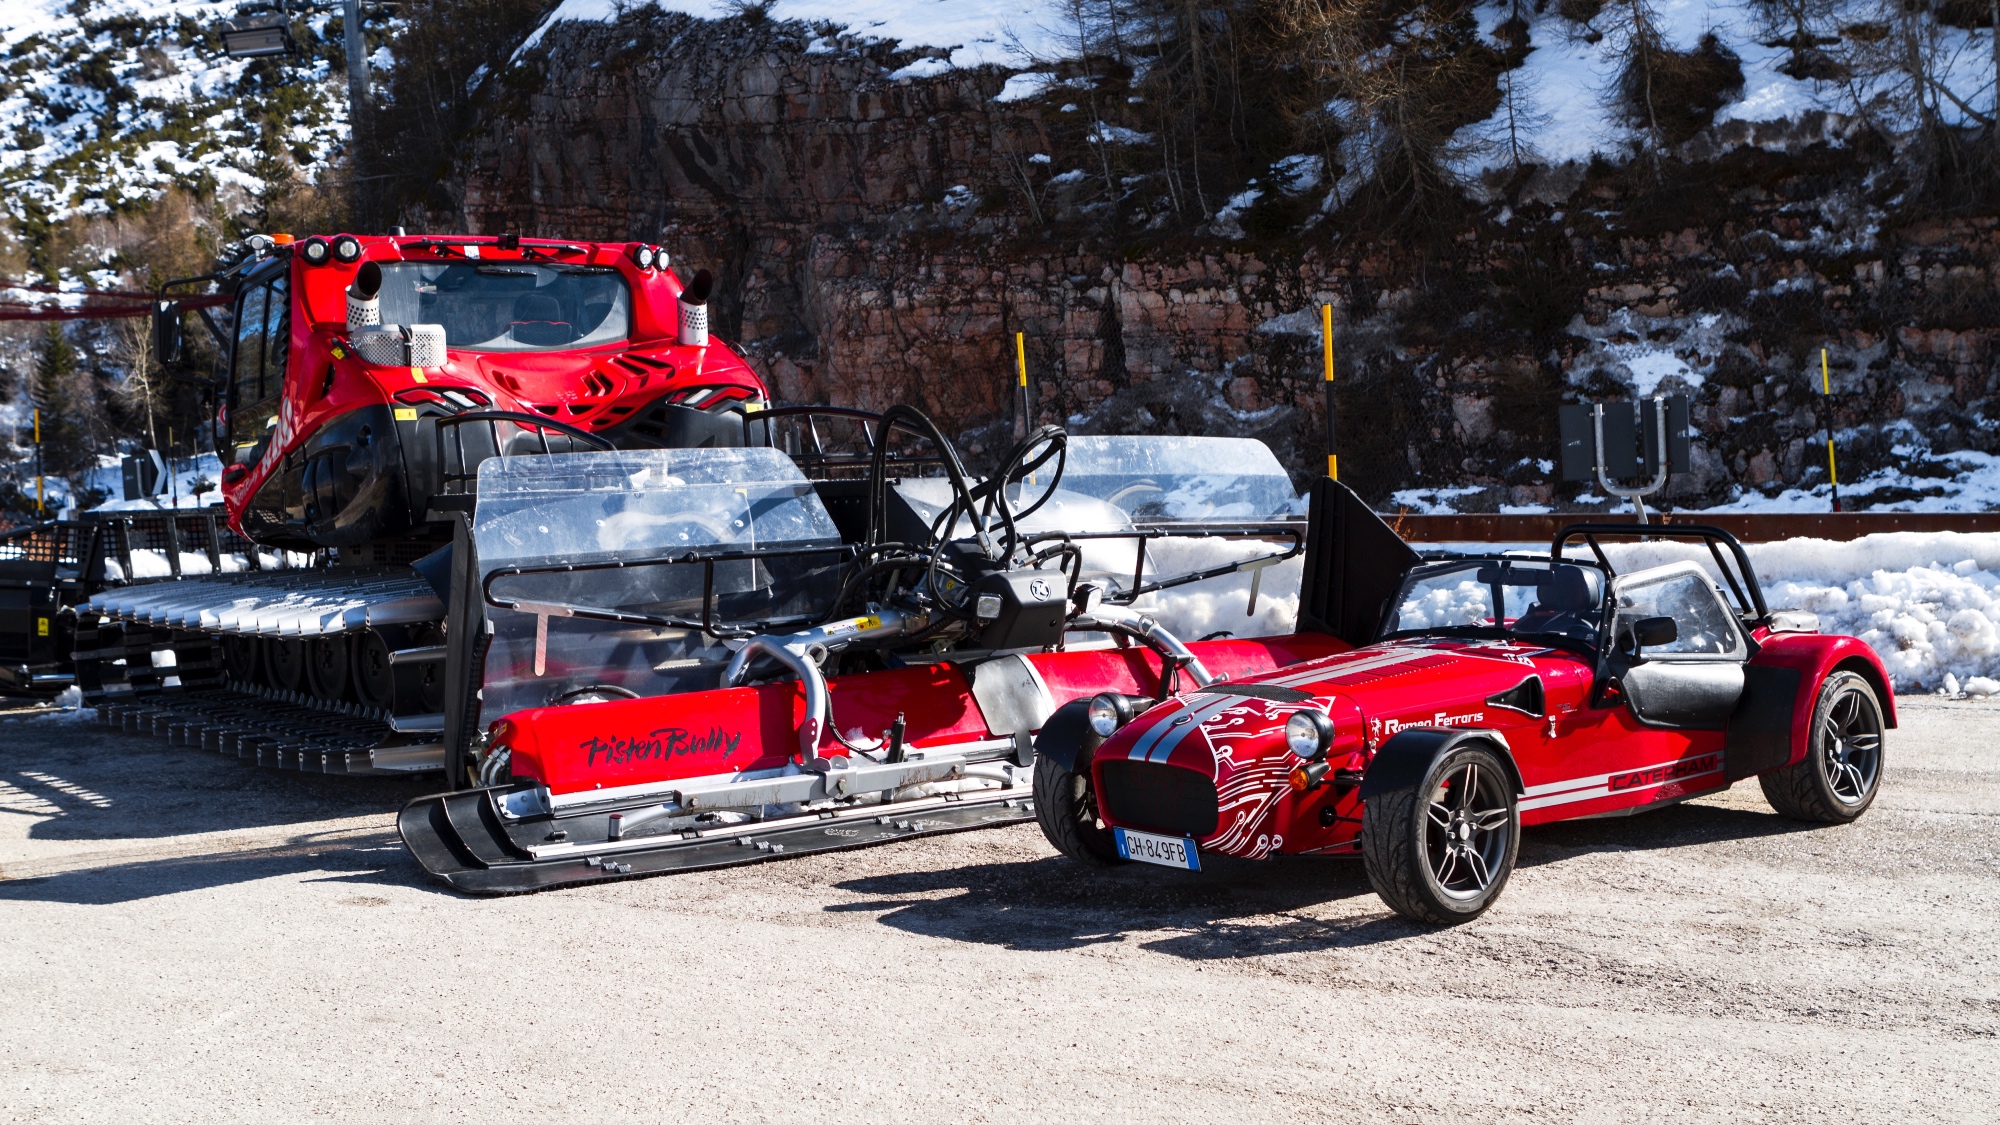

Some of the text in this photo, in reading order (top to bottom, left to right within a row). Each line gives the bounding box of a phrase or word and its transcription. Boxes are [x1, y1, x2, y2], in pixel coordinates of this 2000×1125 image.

[1434, 712, 1484, 727] Ferraris
[579, 725, 742, 768] PistenBully
[1613, 756, 1714, 791] CATERHAM
